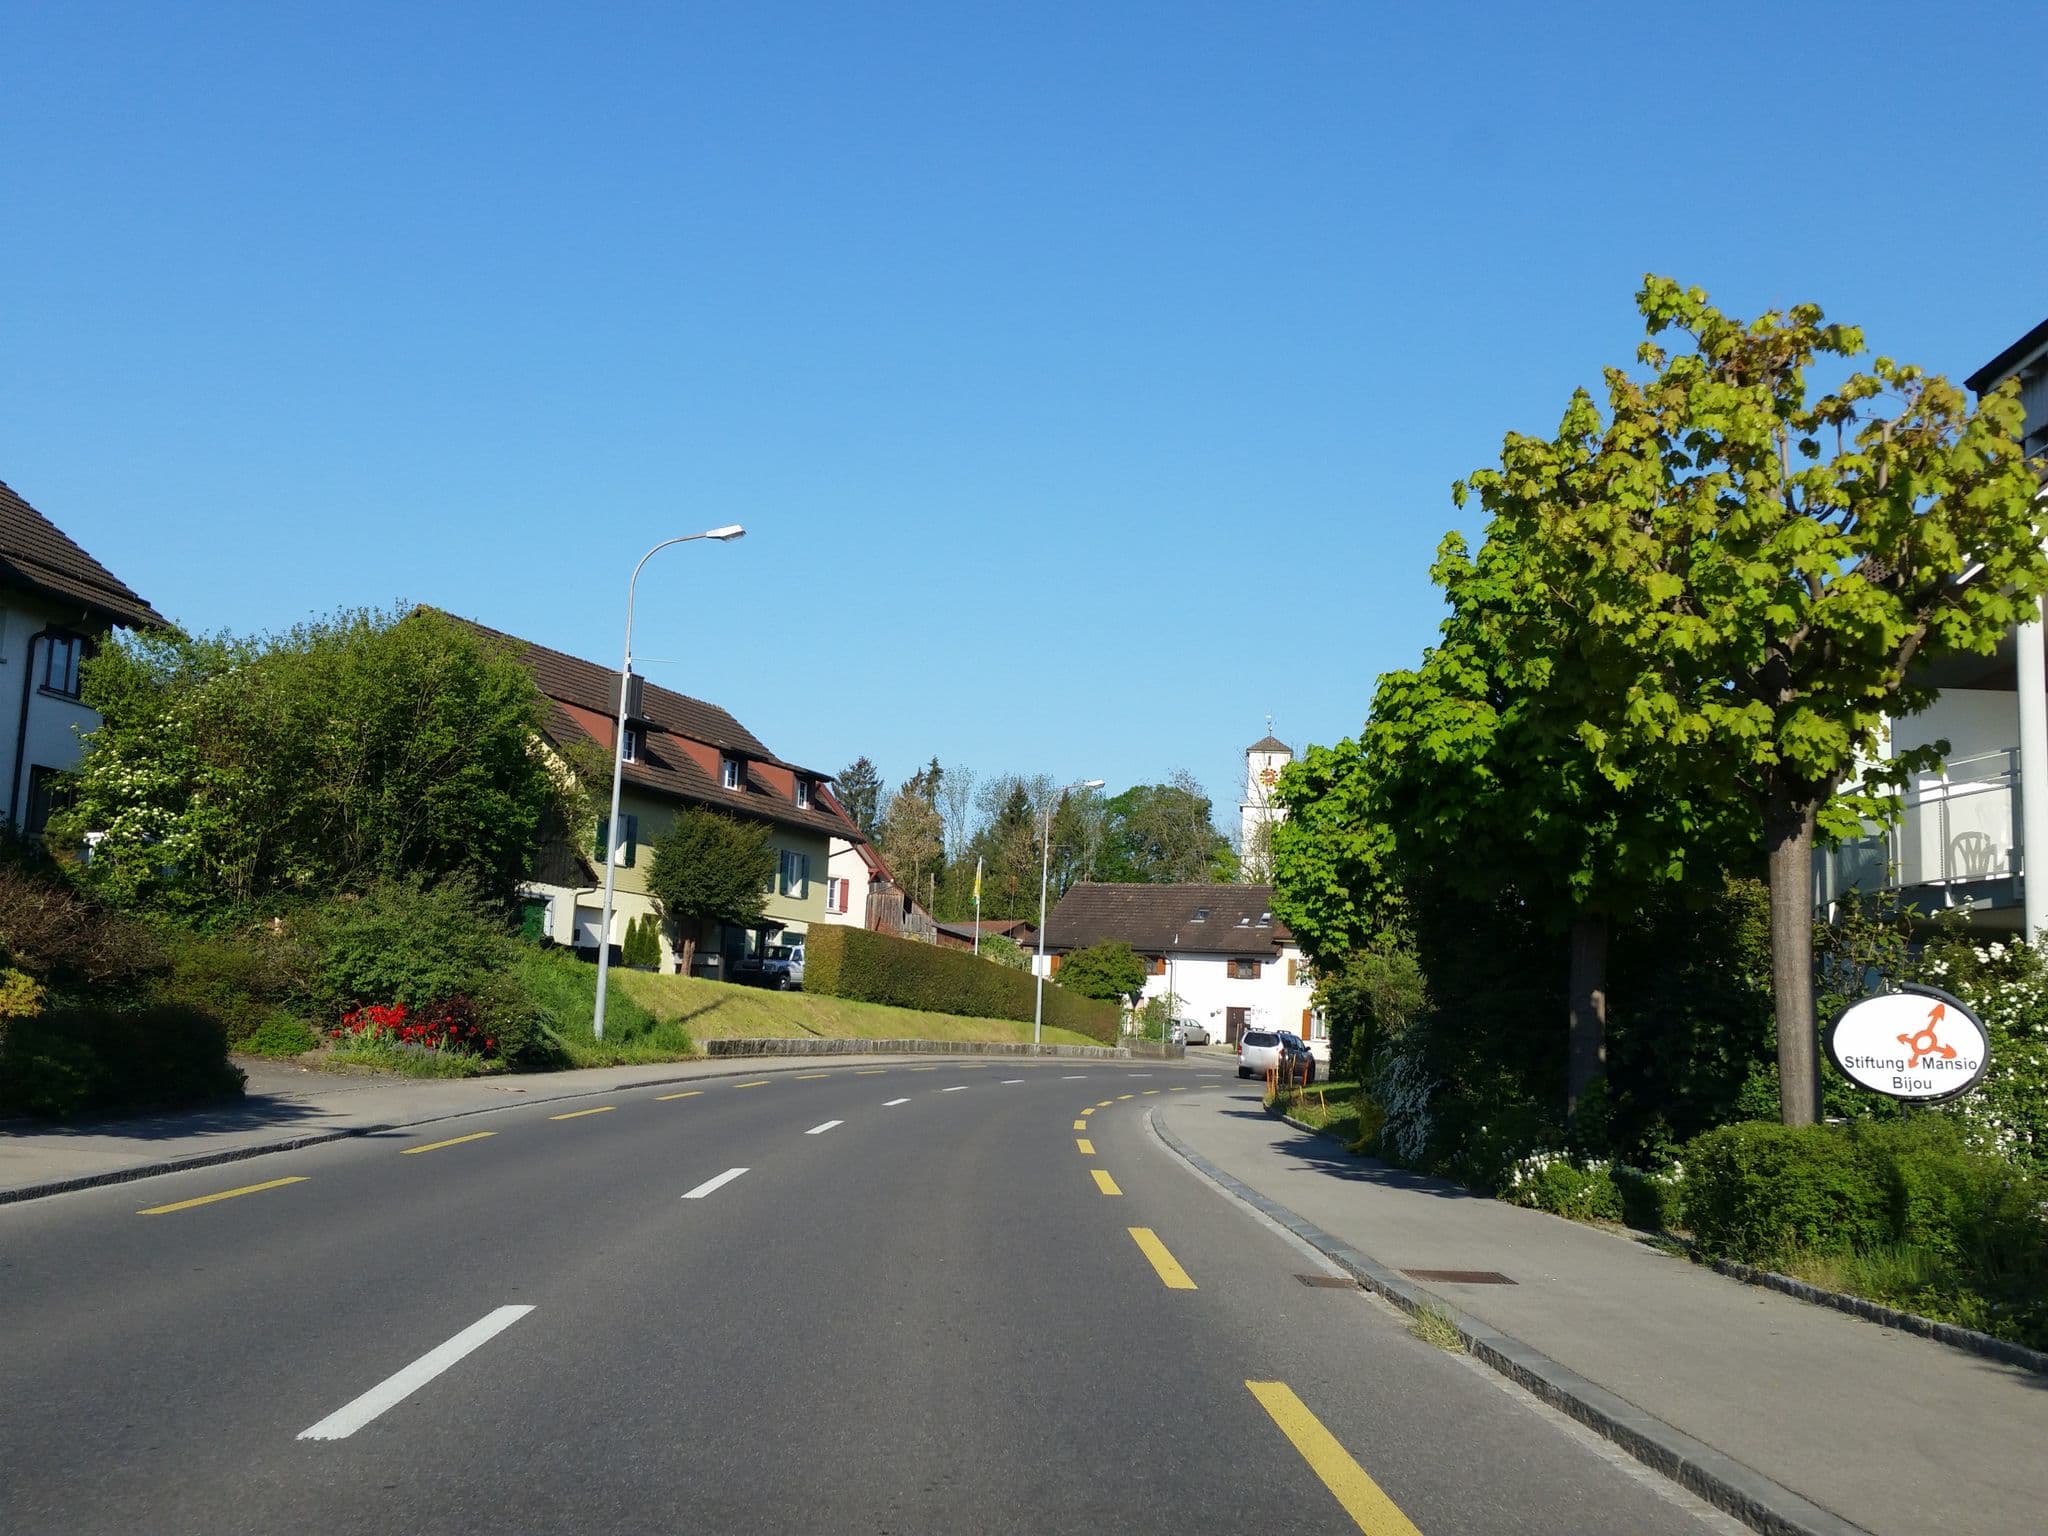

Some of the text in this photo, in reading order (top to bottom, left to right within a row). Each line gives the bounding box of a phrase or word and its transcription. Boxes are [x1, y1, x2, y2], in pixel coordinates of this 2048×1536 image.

[1844, 1056, 1977, 1072] Stiftung Mansio
[1892, 1077, 1932, 1092] Bijou
